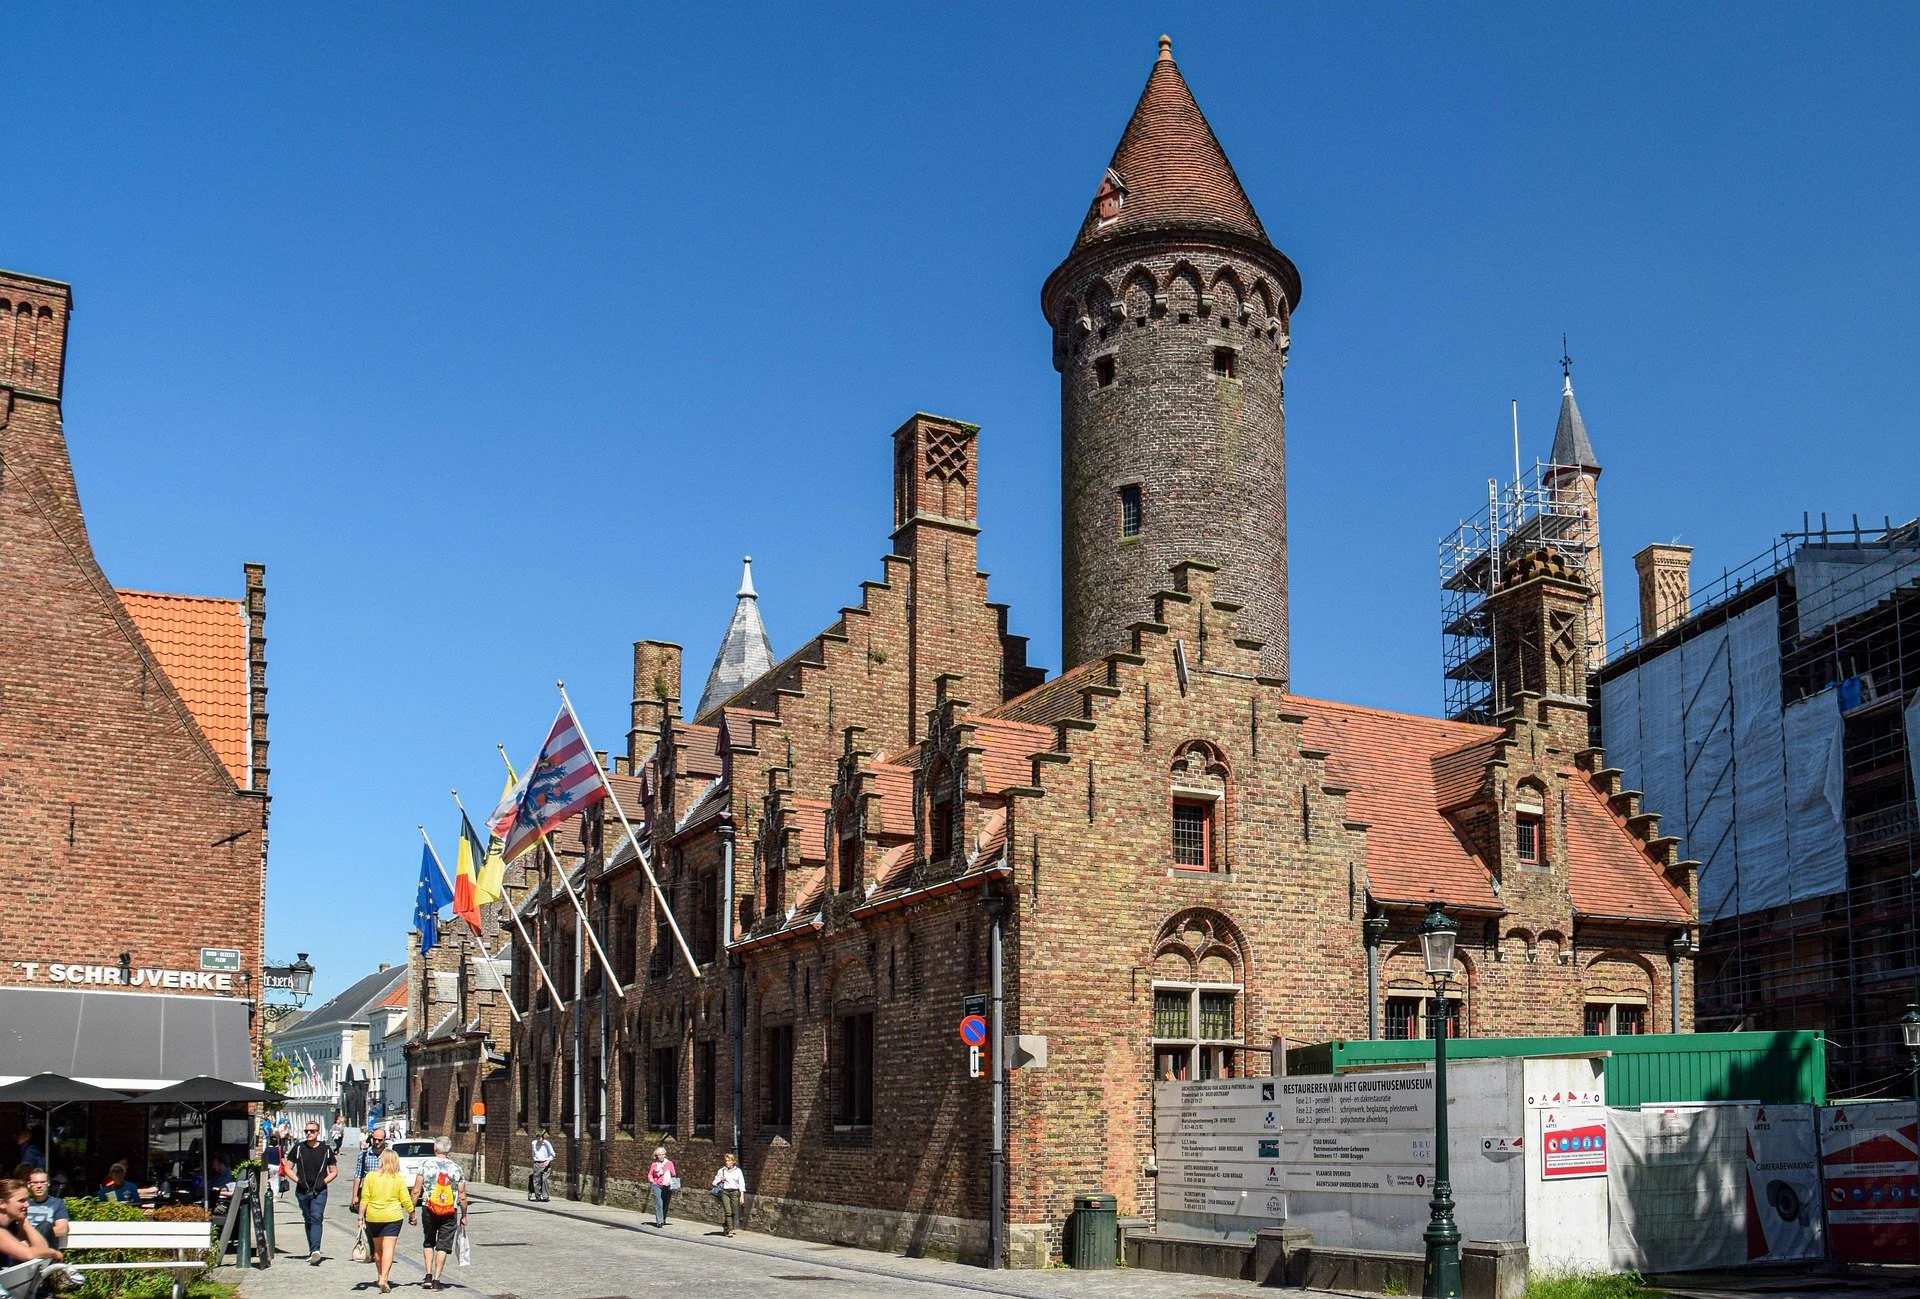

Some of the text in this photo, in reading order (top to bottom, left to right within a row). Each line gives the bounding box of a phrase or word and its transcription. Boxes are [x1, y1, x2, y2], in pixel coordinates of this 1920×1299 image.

[49, 964, 232, 991] SCHRIJVERKE
[1283, 1078, 1432, 1094] RESTAUREREN VAN HET GRUUTHUSEMUSEUM
[1295, 1096, 1305, 1104] Fase
[1295, 1106, 1305, 1114] Fase
[1389, 1103, 1418, 1113] pleisterwerk
[1296, 1116, 1305, 1124] Fase
[1756, 1162, 1814, 1171] CAMERABEWAKING
